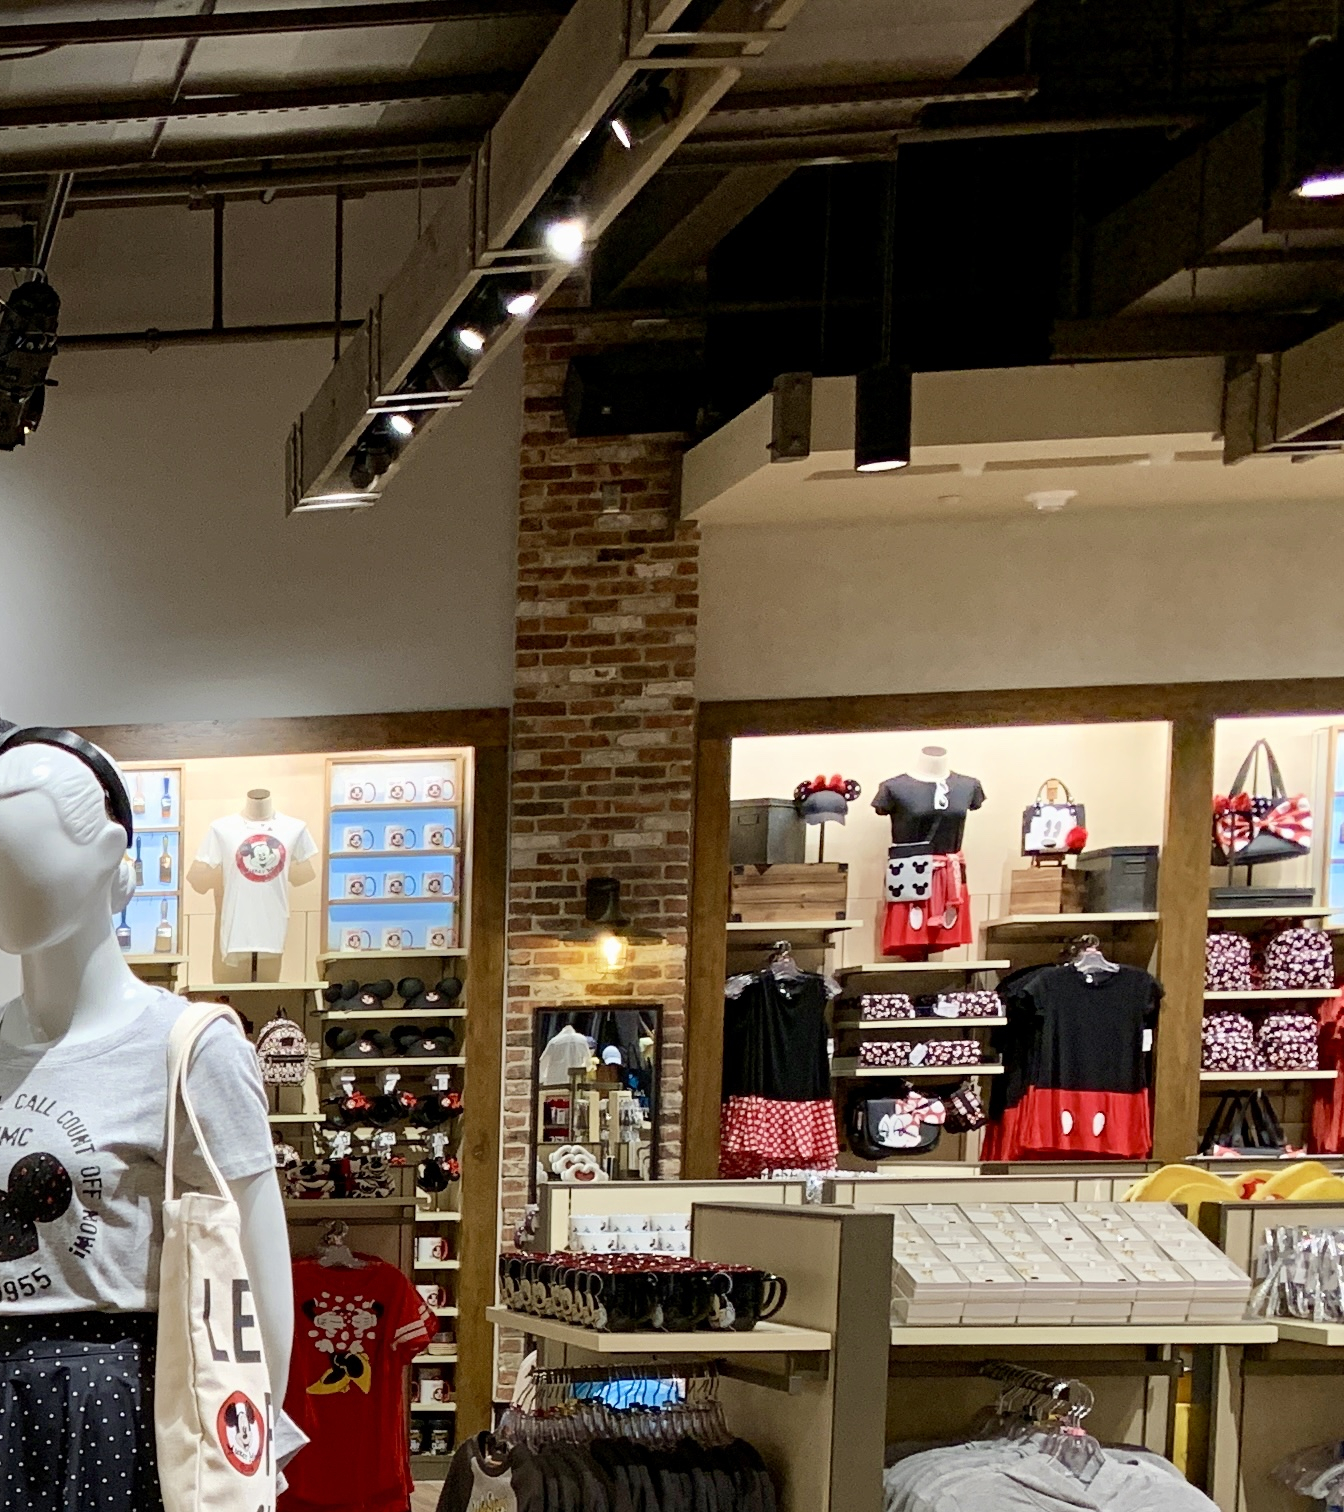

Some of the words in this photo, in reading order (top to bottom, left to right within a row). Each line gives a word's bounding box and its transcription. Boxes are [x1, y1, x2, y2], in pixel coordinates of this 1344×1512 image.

[14, 1093, 58, 1118] CALL
[56, 1110, 98, 1156] COUNT
[80, 1165, 103, 1200] OFF
